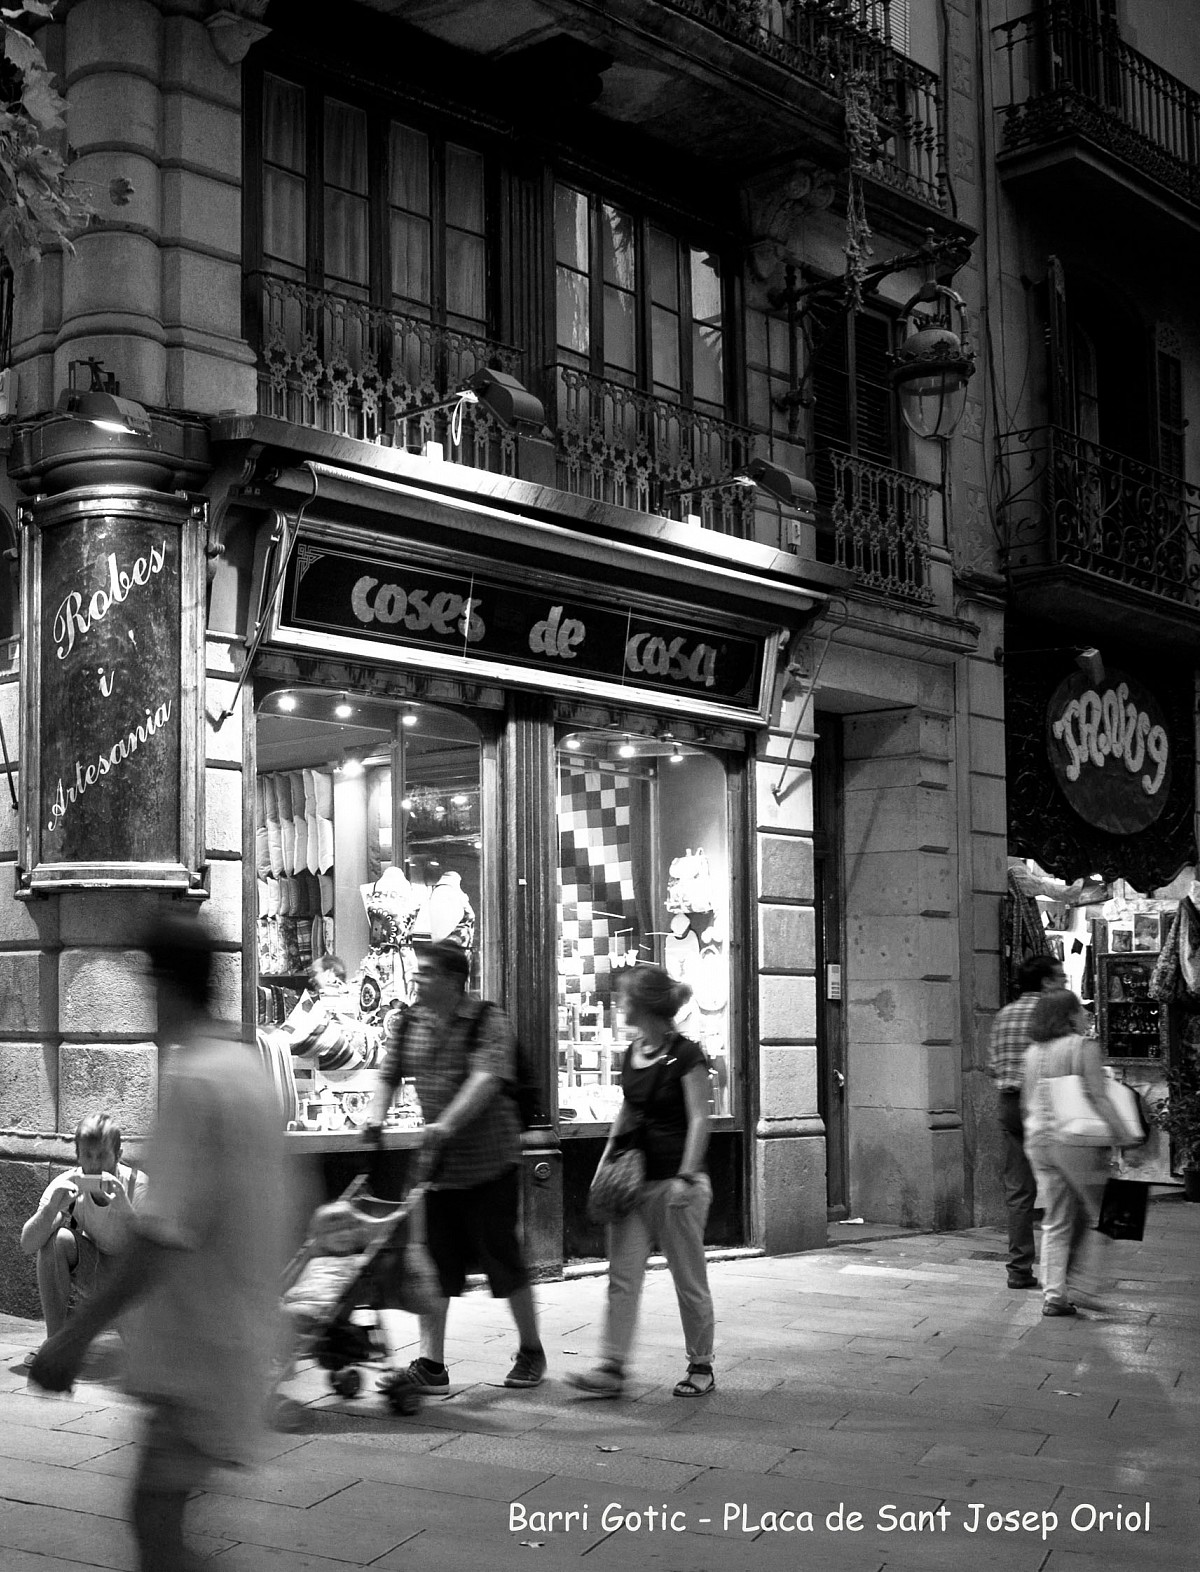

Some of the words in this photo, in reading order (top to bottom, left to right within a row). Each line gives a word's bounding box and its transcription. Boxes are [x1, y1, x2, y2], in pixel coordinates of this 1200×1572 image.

[53, 540, 166, 660] Robes
[351, 575, 486, 642] coses
[528, 605, 586, 658] de
[626, 632, 716, 687] casa
[97, 667, 115, 697] i
[48, 700, 172, 831] Artesania
